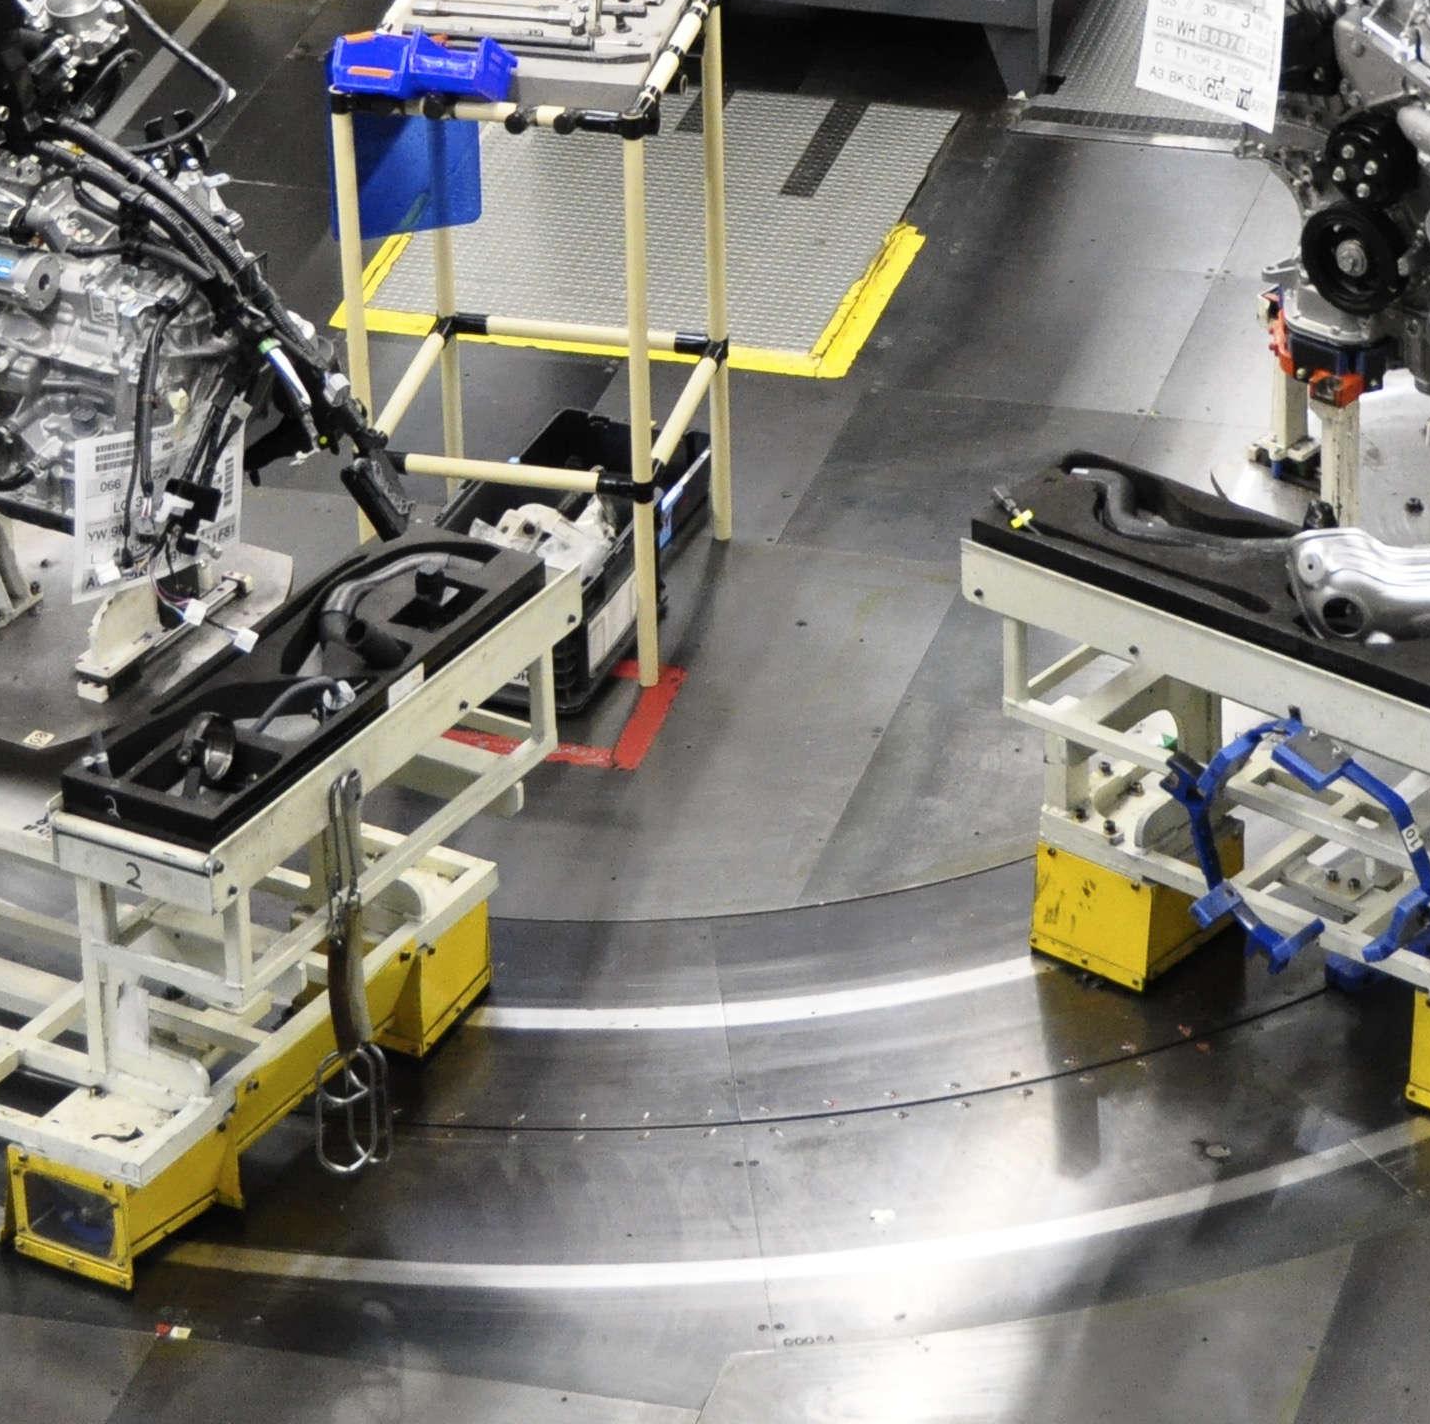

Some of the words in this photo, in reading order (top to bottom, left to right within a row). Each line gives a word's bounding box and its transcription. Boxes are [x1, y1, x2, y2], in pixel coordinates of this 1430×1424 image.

[1177, 20, 1196, 39] WH
[1149, 66, 1164, 79] A3
[1169, 70, 1184, 84] BK
[100, 479, 121, 492] 066
[88, 529, 108, 541] YW
[104, 795, 121, 820] 2
[126, 861, 143, 890] 2
